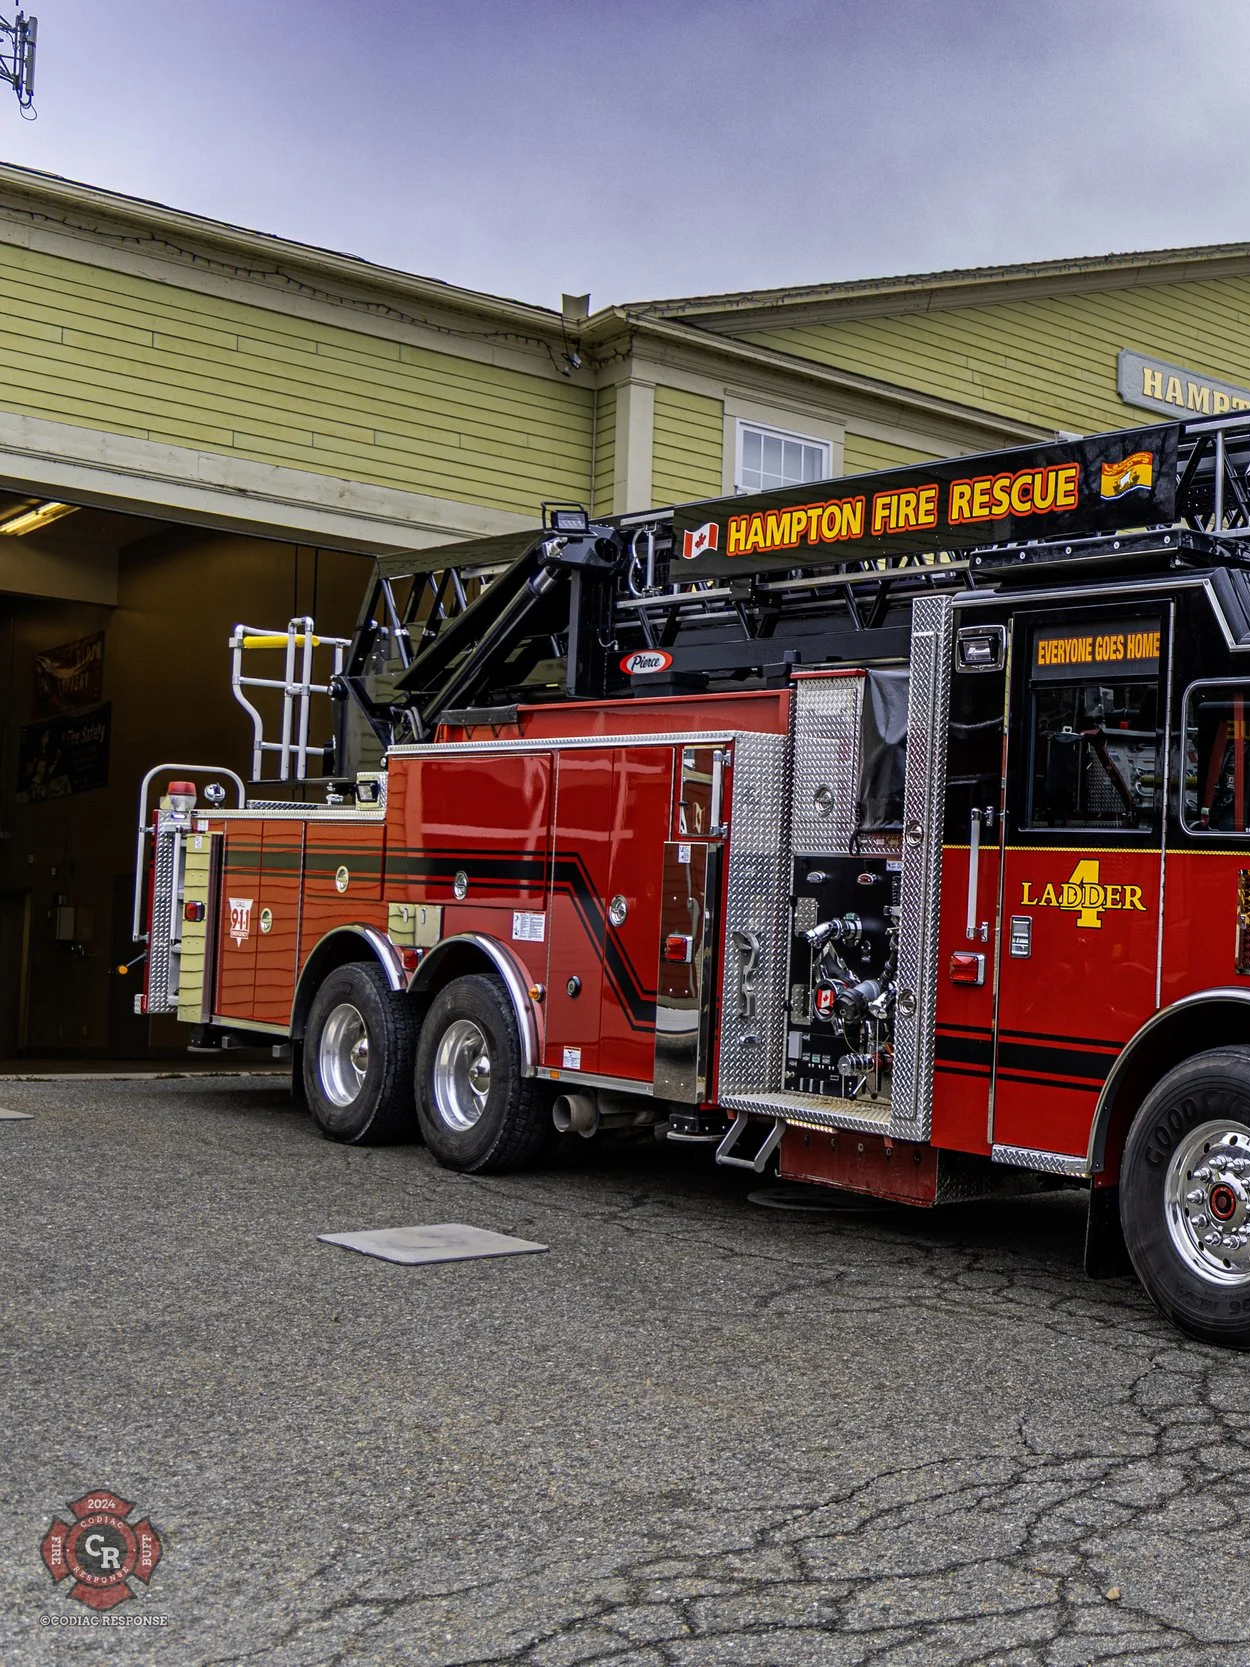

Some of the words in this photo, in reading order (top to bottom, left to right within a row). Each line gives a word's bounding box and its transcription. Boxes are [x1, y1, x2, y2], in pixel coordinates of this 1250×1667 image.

[727, 496, 864, 557] HAMPTON
[873, 485, 937, 533] FIRE
[949, 463, 1080, 522] RESCUE
[631, 655, 661, 671] Pierce
[1038, 638, 1093, 664] EVERYONE
[1095, 635, 1124, 660] GOES
[1127, 632, 1160, 659] HOME
[1021, 882, 1147, 911] LADDER
